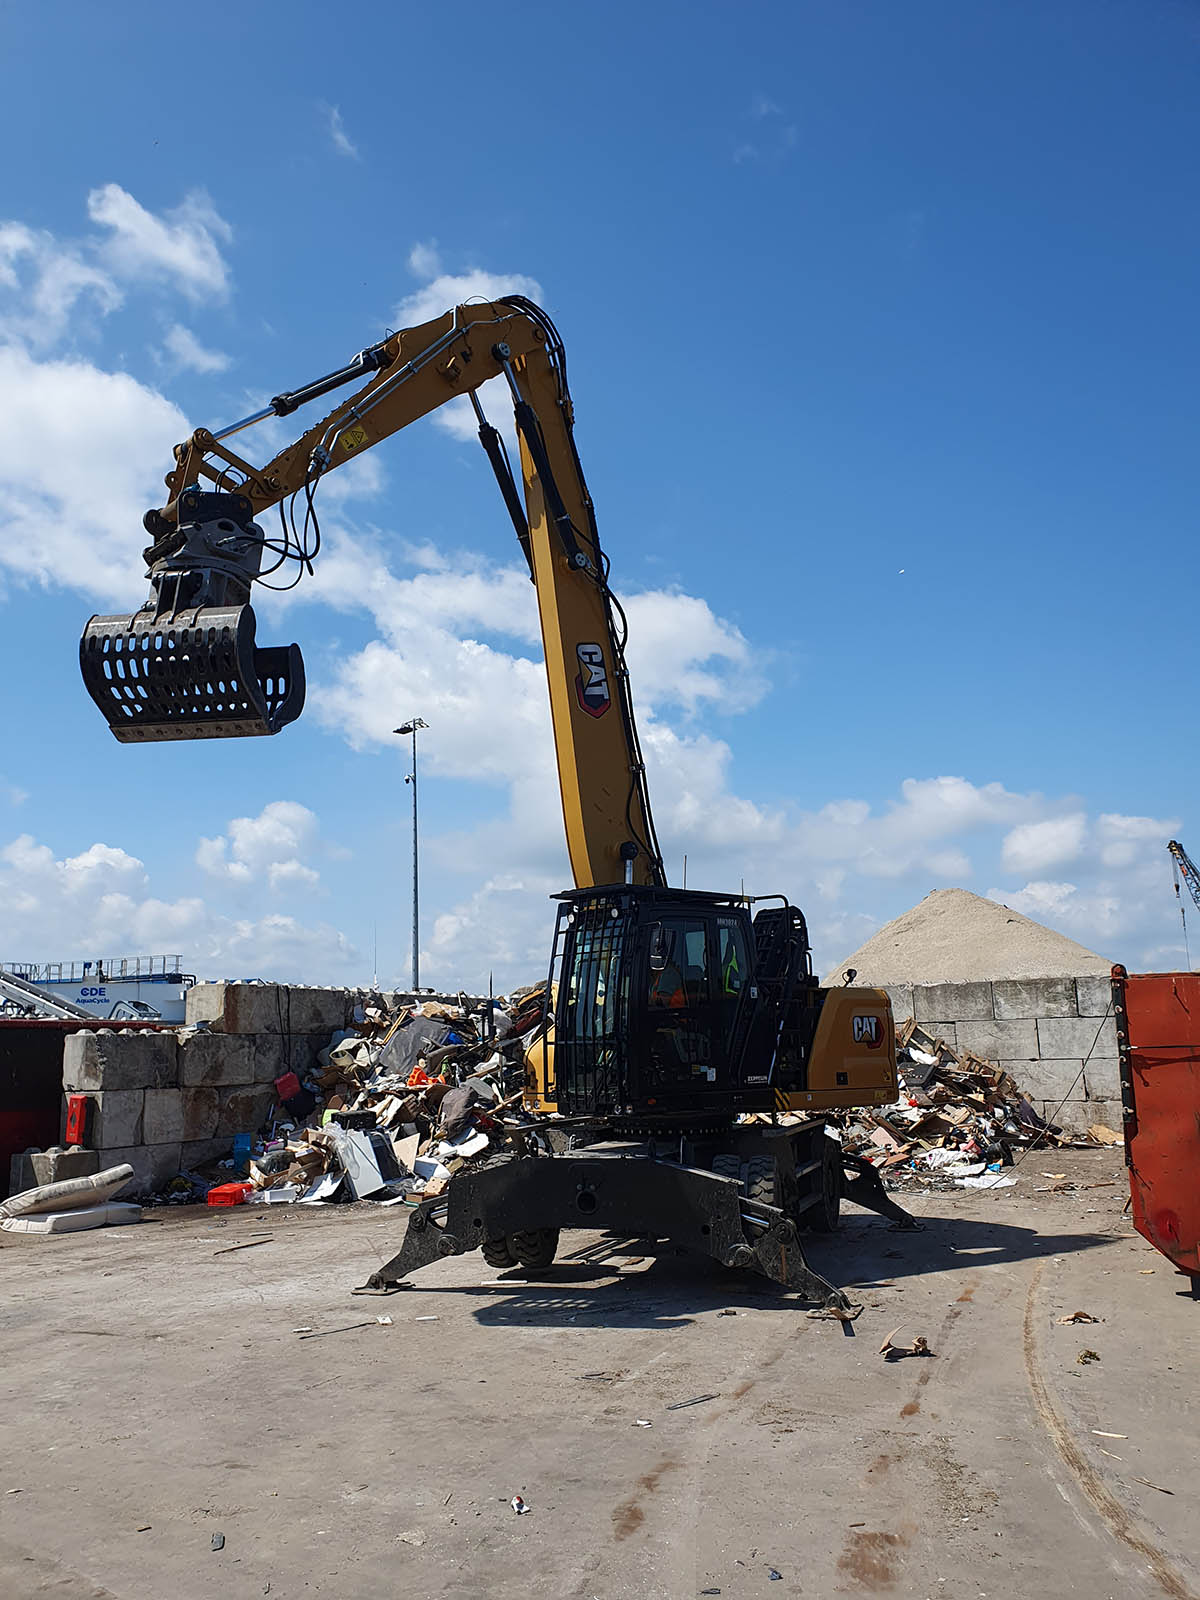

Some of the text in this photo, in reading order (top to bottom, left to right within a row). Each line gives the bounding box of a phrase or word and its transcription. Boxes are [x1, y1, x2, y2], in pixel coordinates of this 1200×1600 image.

[577, 643, 610, 700] CAT
[80, 987, 106, 996] CDE
[853, 1016, 877, 1042] CAT
